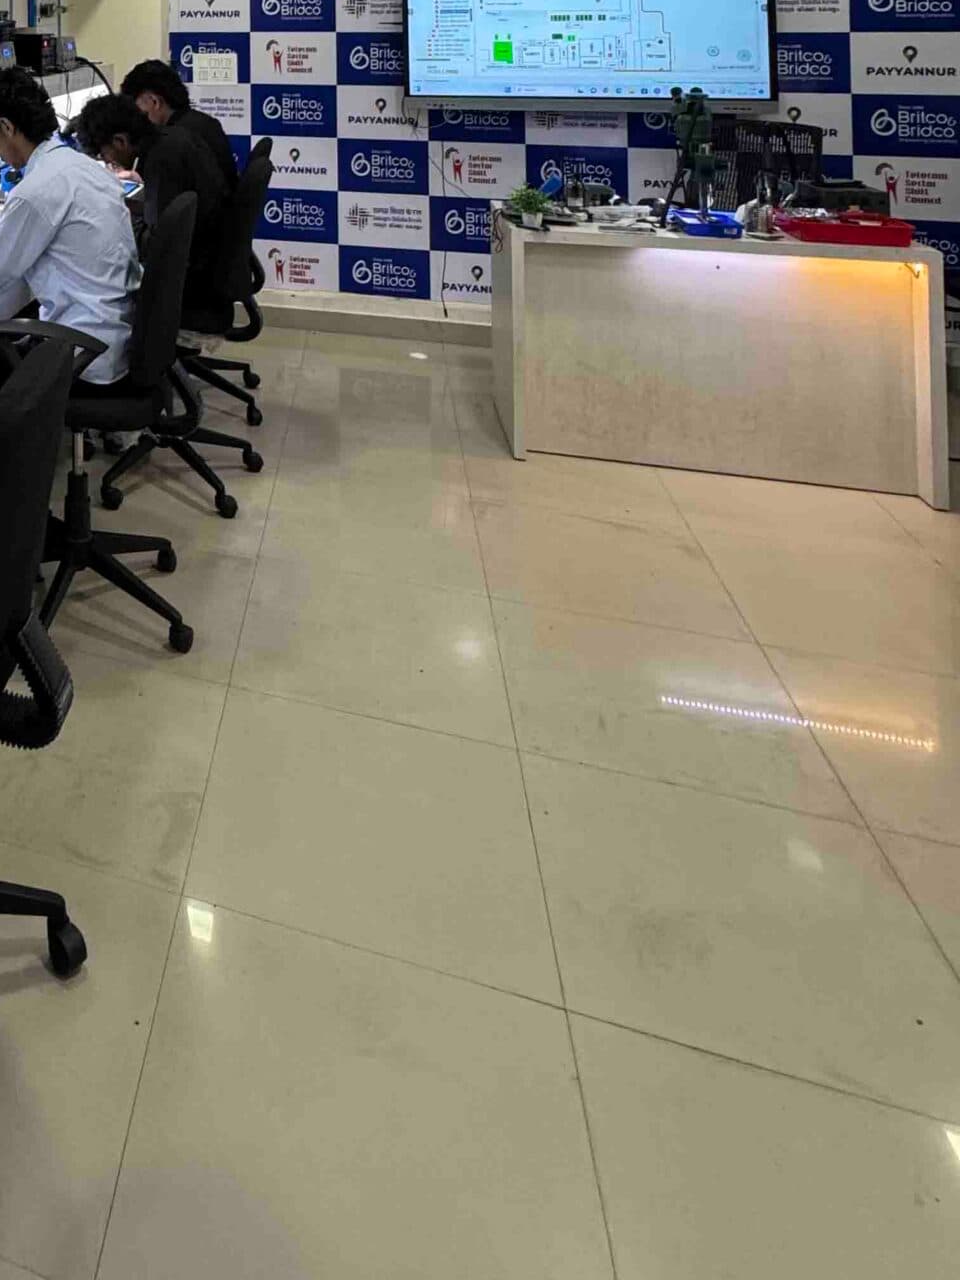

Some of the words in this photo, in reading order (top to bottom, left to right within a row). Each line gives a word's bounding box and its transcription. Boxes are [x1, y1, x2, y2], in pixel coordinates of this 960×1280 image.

[281, 5, 321, 16] Bridco
[896, 0, 953, 12] Bridco
[180, 10, 240, 18] PAYYANNUR
[370, 60, 402, 70] Bridc
[777, 62, 831, 75] Bridco
[866, 66, 957, 77] PAYYANNUR
[282, 109, 322, 120] Bridco
[464, 113, 510, 126] Bridco
[898, 124, 955, 138] Bridco
[272, 167, 327, 175] AYYANNUR
[372, 166, 414, 179] Bridco
[283, 214, 323, 226] Bridco
[373, 275, 416, 288] Bridco
